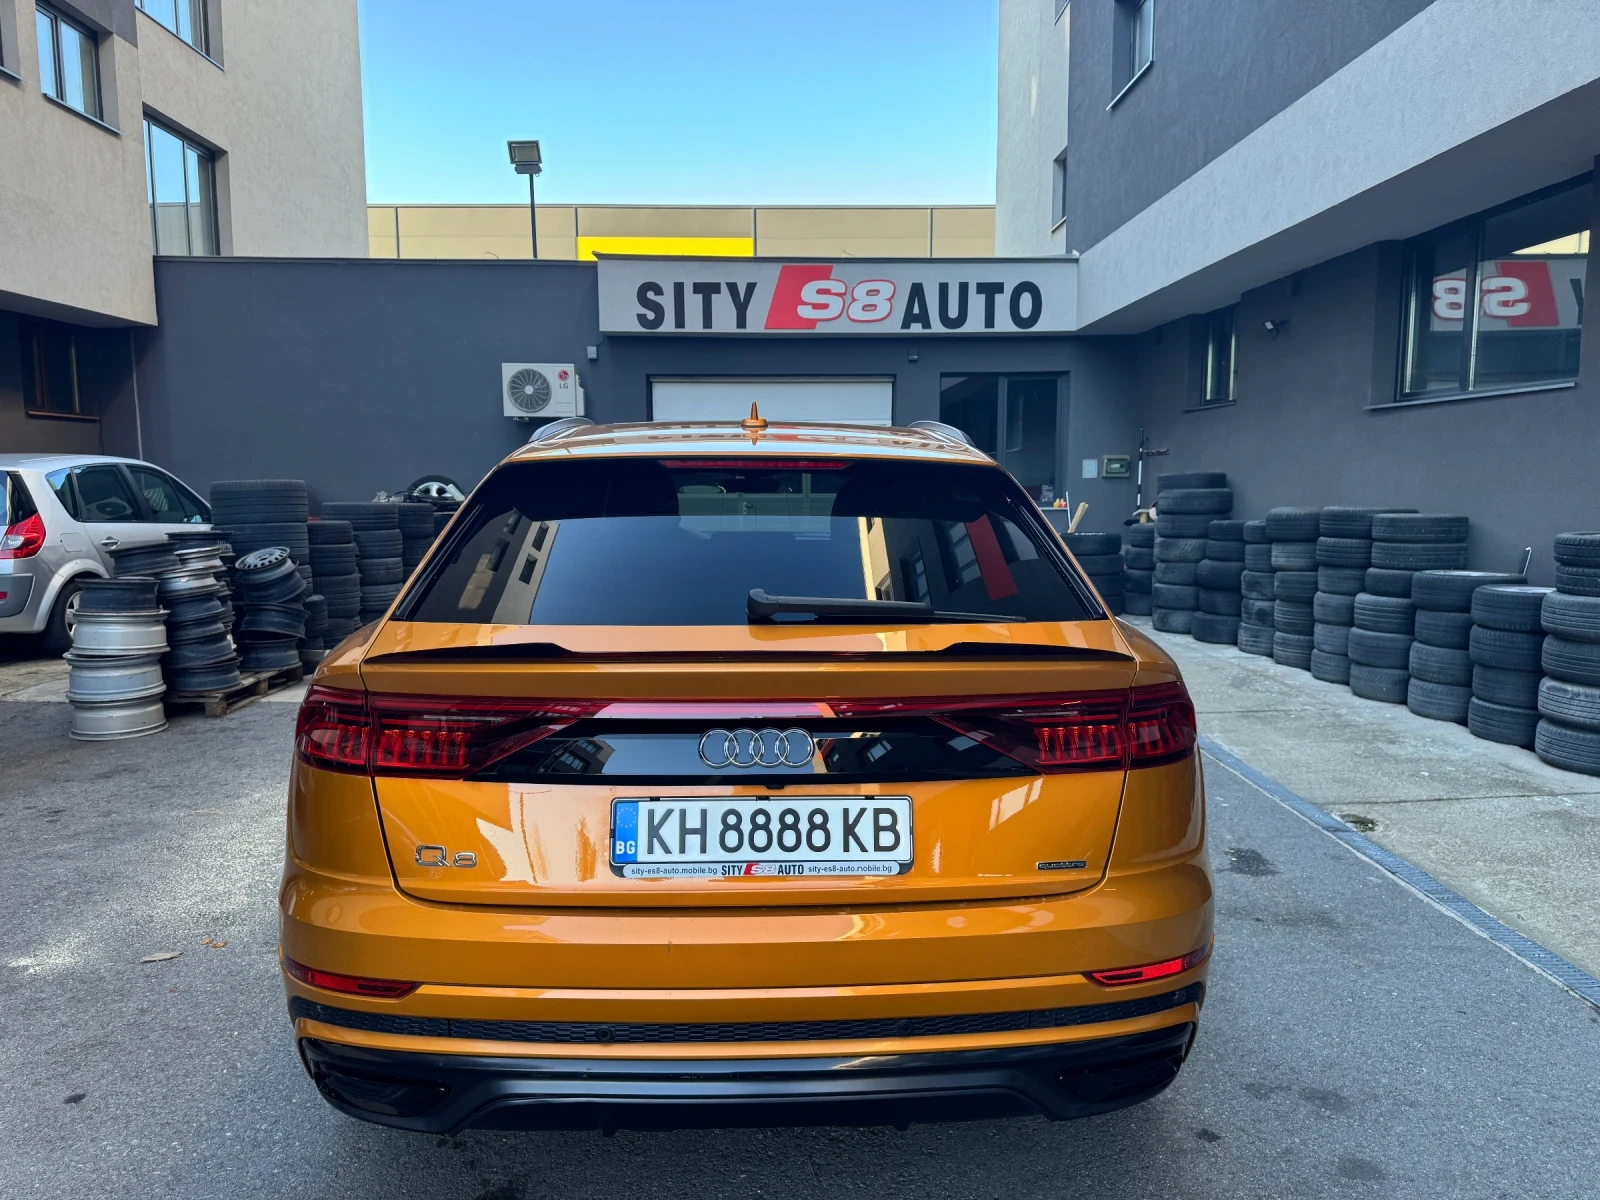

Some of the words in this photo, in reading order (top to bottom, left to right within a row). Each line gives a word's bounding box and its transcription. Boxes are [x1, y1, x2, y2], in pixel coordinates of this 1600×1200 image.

[636, 281, 758, 331] SITY
[796, 278, 896, 324] S8
[901, 280, 1043, 331] AUTO
[615, 840, 636, 855] BG
[646, 808, 708, 855] KH
[719, 808, 831, 854] 8888
[842, 806, 901, 853] KB
[415, 844, 477, 868] Q8
[631, 866, 718, 876] sity-es8-auto.mobile.bg
[721, 865, 743, 876] SITY
[777, 864, 805, 875] AUTO
